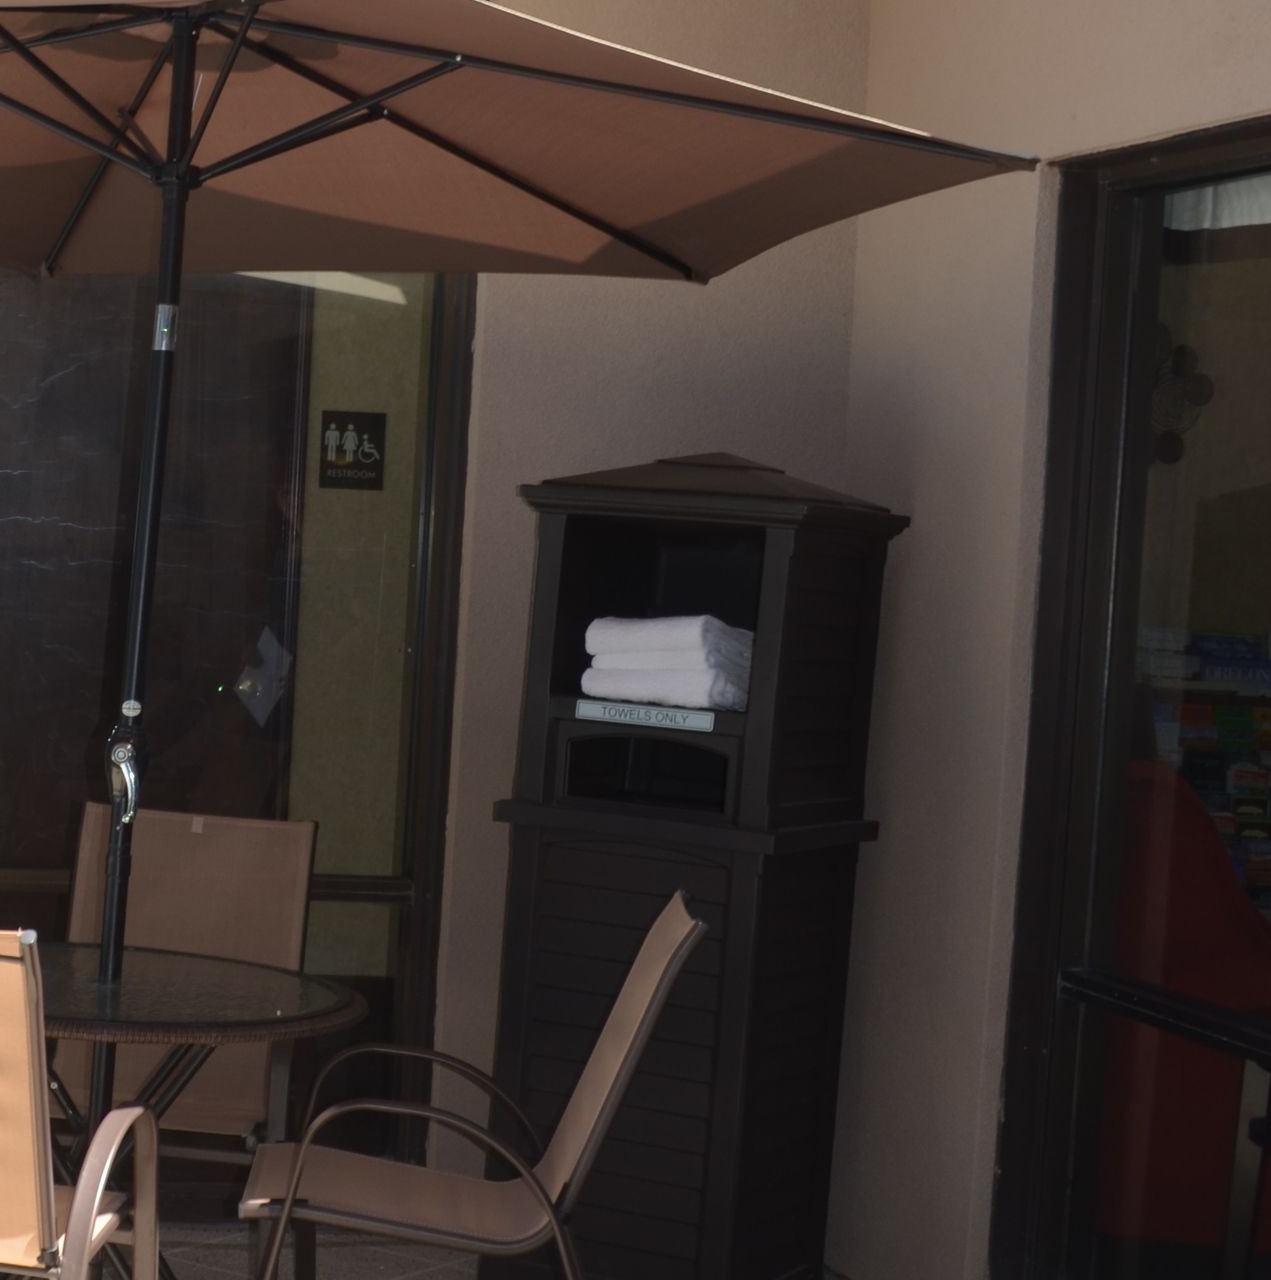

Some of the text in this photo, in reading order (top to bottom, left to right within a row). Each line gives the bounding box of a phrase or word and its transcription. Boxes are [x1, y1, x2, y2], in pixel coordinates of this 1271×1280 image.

[327, 469, 376, 479] RESTROOM
[601, 706, 689, 725] TOWELS ONLY
